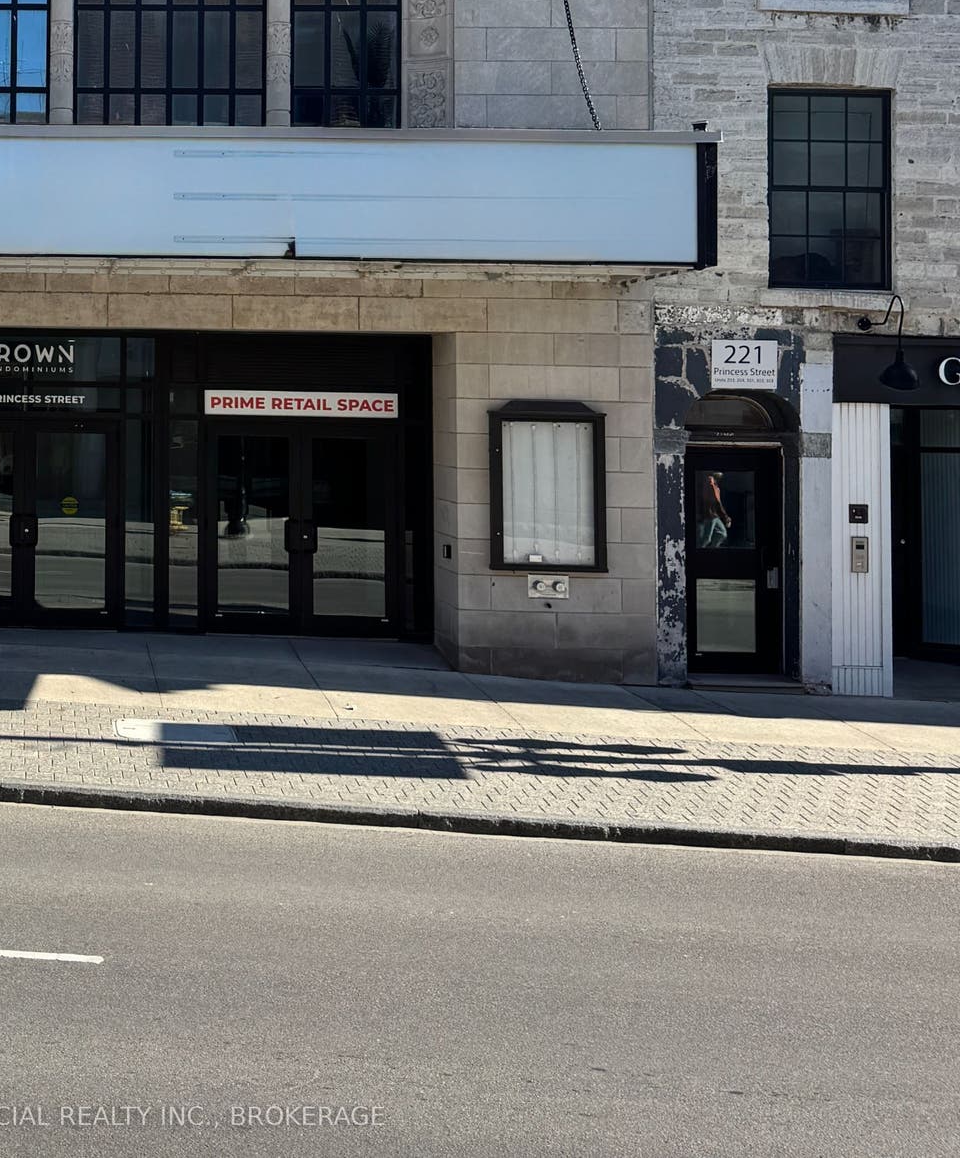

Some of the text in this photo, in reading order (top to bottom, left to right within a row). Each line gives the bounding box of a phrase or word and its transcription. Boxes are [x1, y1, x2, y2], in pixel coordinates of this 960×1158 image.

[723, 345, 761, 364] 221
[713, 368, 776, 376] Princess Street
[44, 395, 85, 404] STREET
[210, 396, 395, 412] PRIME RETAIL SPACE
